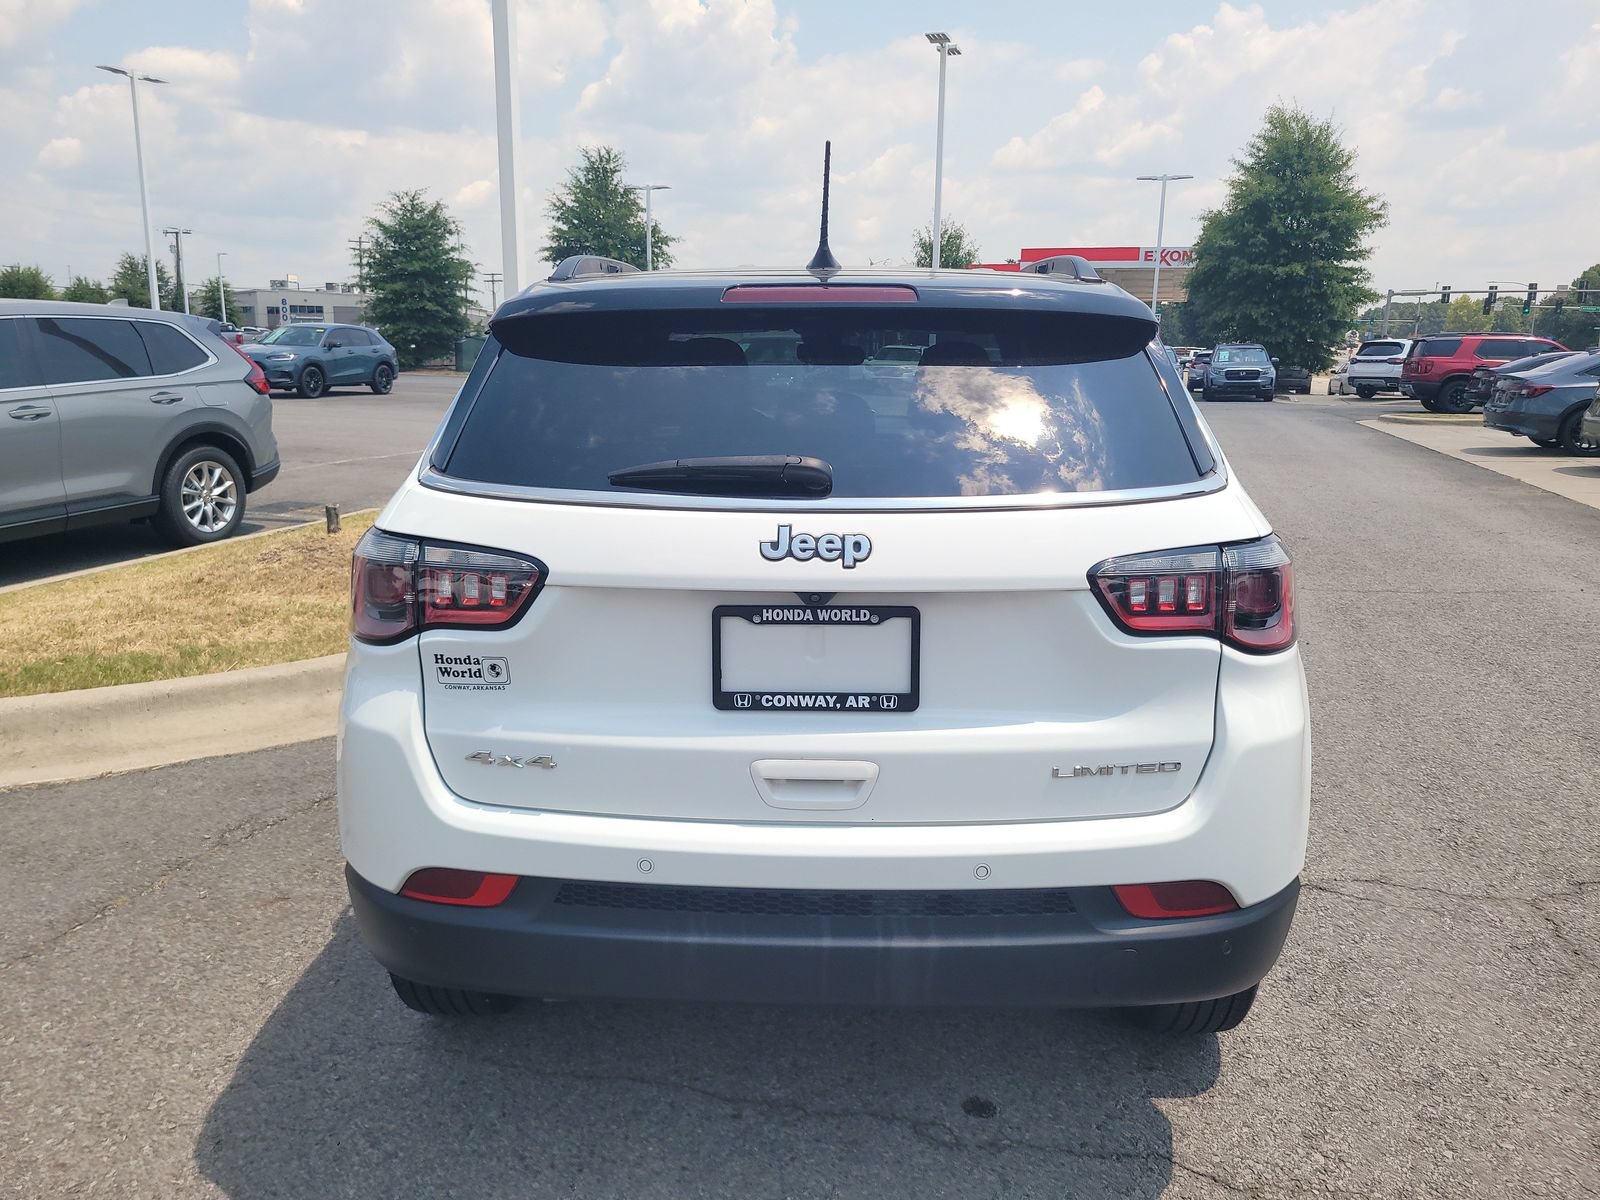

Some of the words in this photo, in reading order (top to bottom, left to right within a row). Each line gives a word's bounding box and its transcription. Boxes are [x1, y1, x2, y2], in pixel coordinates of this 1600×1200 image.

[281, 298, 289, 321] 800
[760, 524, 872, 569] Jeep
[762, 608, 813, 621] HONDA
[817, 609, 870, 621] WORLD
[434, 653, 481, 666] Honda
[438, 666, 483, 679] World
[761, 694, 841, 709] CONWAY,
[845, 695, 870, 708] AR
[1051, 760, 1182, 778] LIMITED
